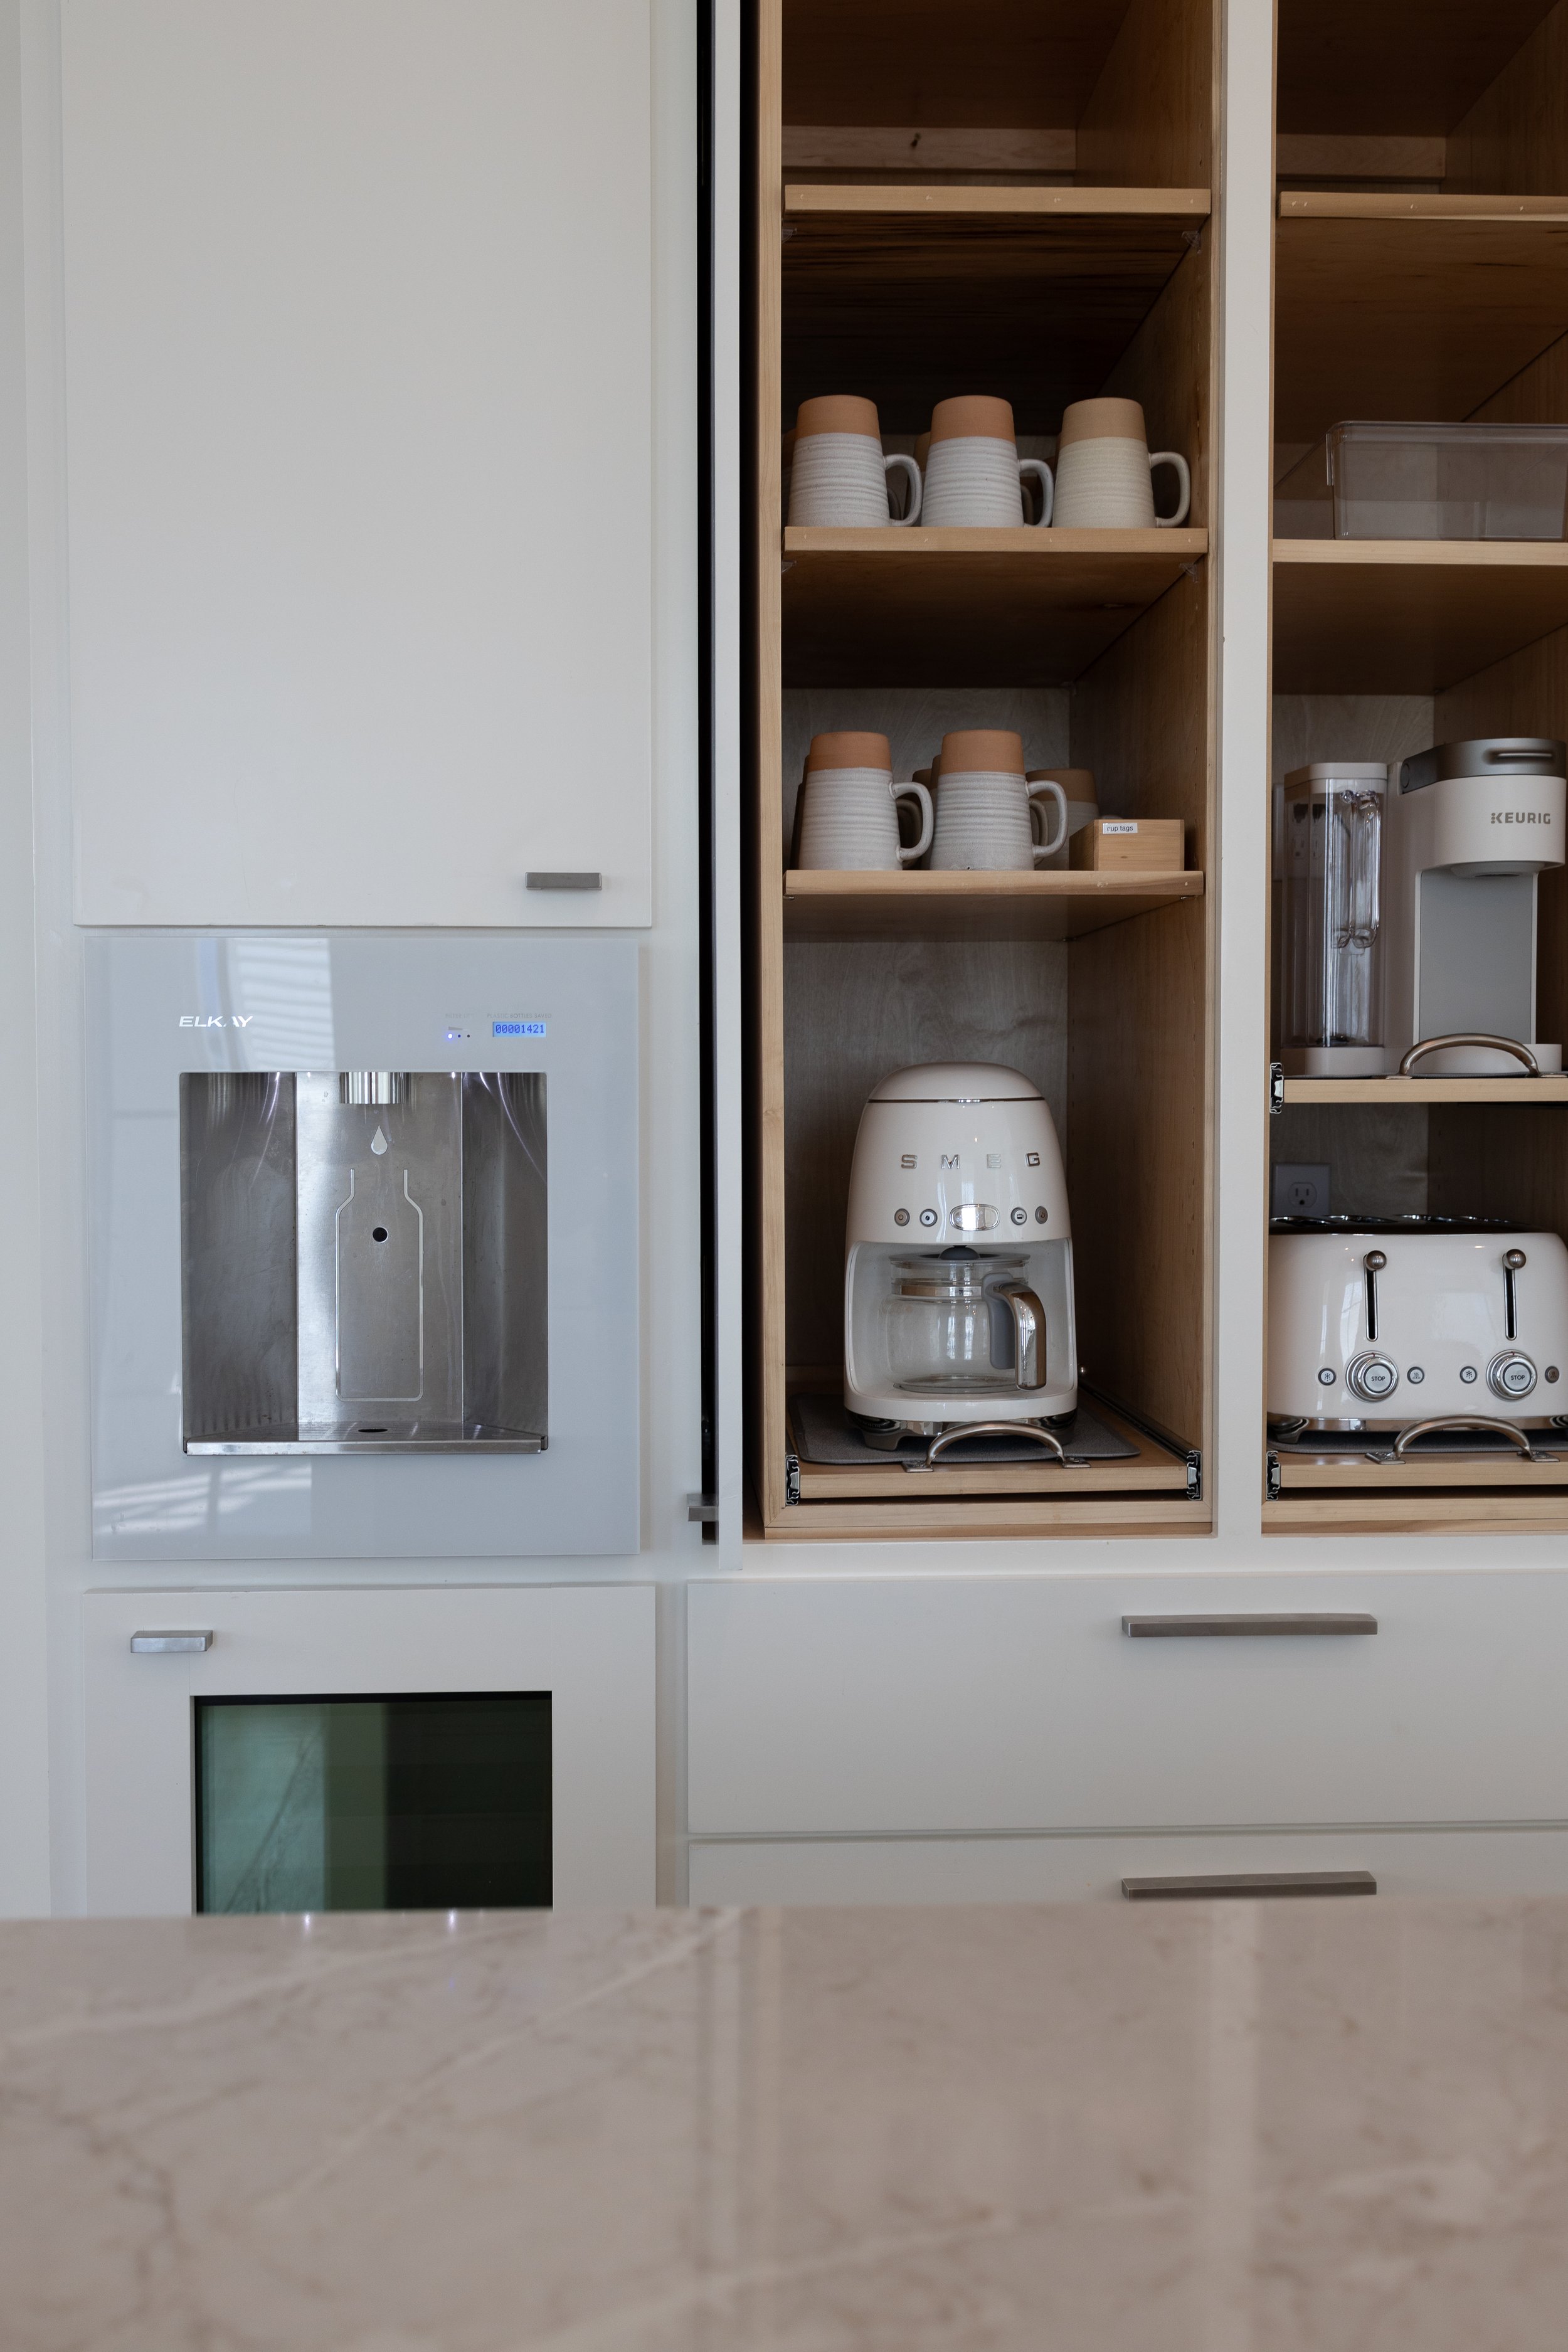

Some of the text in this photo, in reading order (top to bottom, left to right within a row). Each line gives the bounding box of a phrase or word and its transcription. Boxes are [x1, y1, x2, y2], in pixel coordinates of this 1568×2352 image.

[1491, 812, 1551, 824] KEURIG
[495, 1024, 544, 1034] 00001421
[901, 1152, 1041, 1170] SMEG
